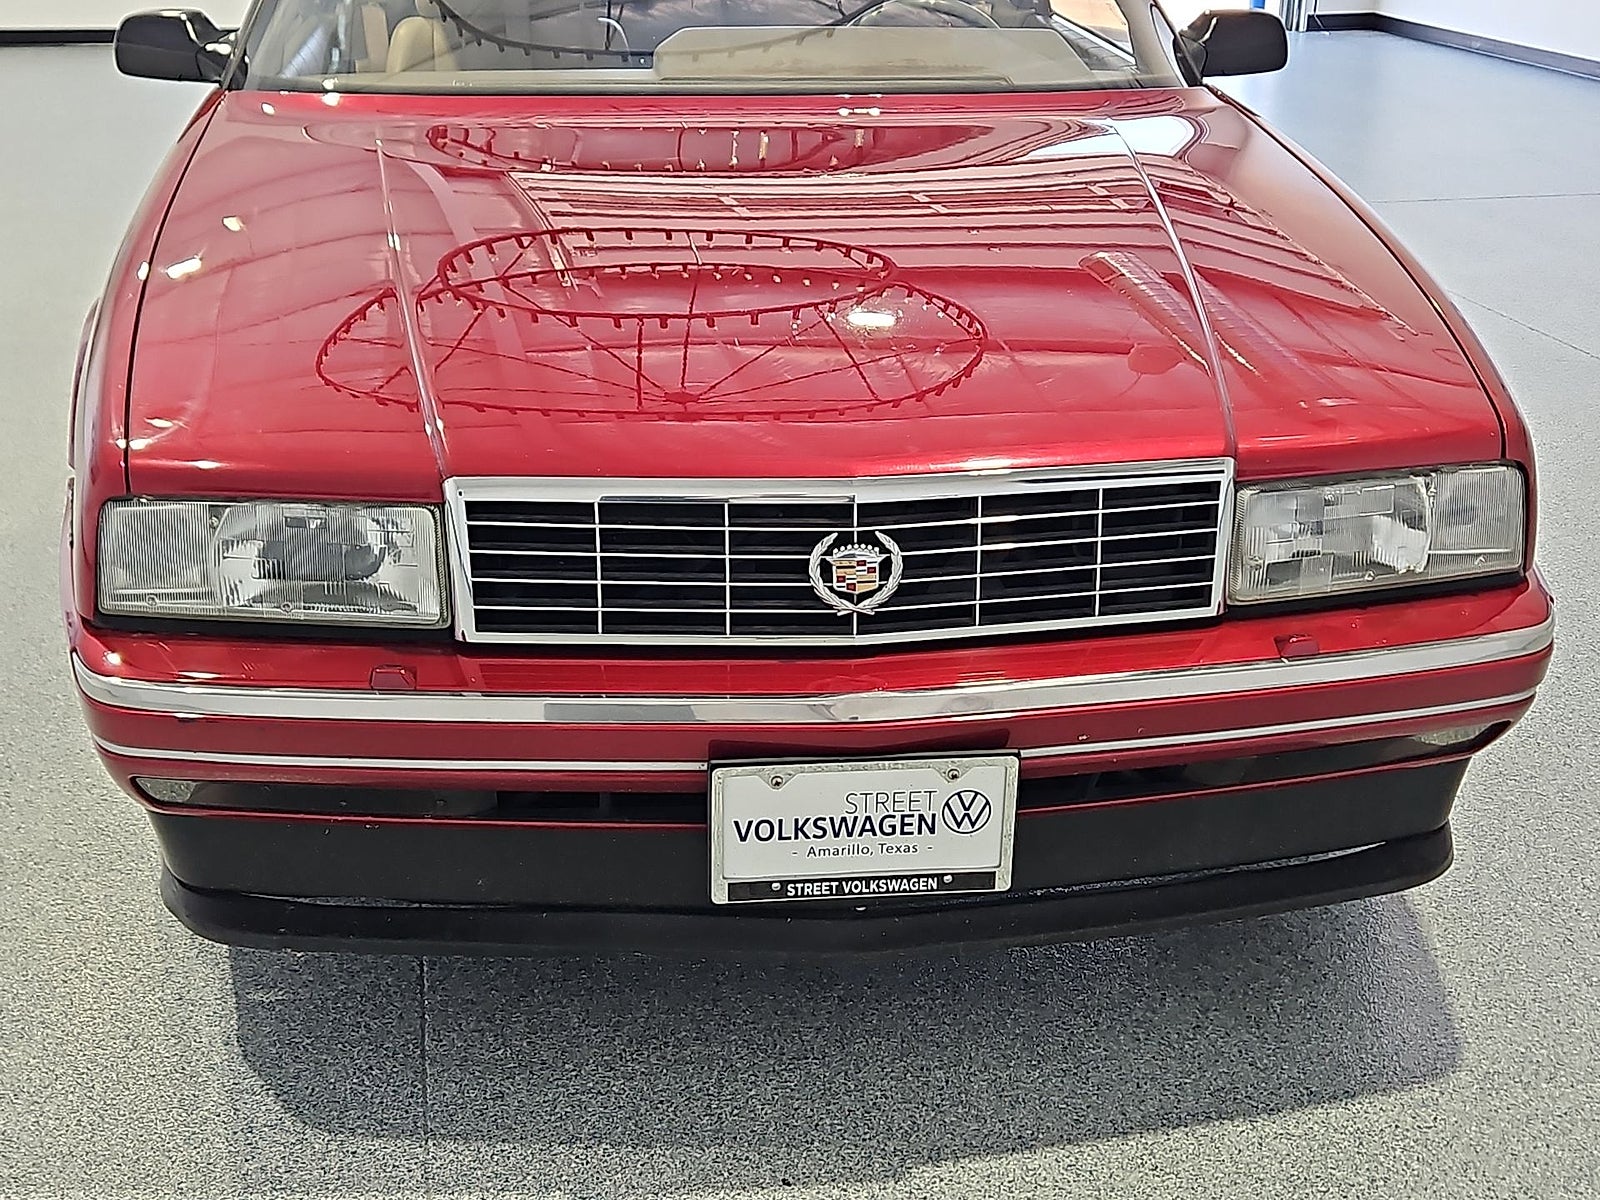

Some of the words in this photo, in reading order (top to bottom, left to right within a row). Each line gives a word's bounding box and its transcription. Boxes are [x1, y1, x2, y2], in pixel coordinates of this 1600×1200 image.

[845, 790, 937, 814] STREET
[733, 813, 936, 842] VOLKSWAGEN
[807, 843, 873, 858] Amarillo,
[878, 843, 918, 854] Texas
[787, 881, 837, 896] STREET
[842, 877, 937, 894] VOLKSWAGEN
